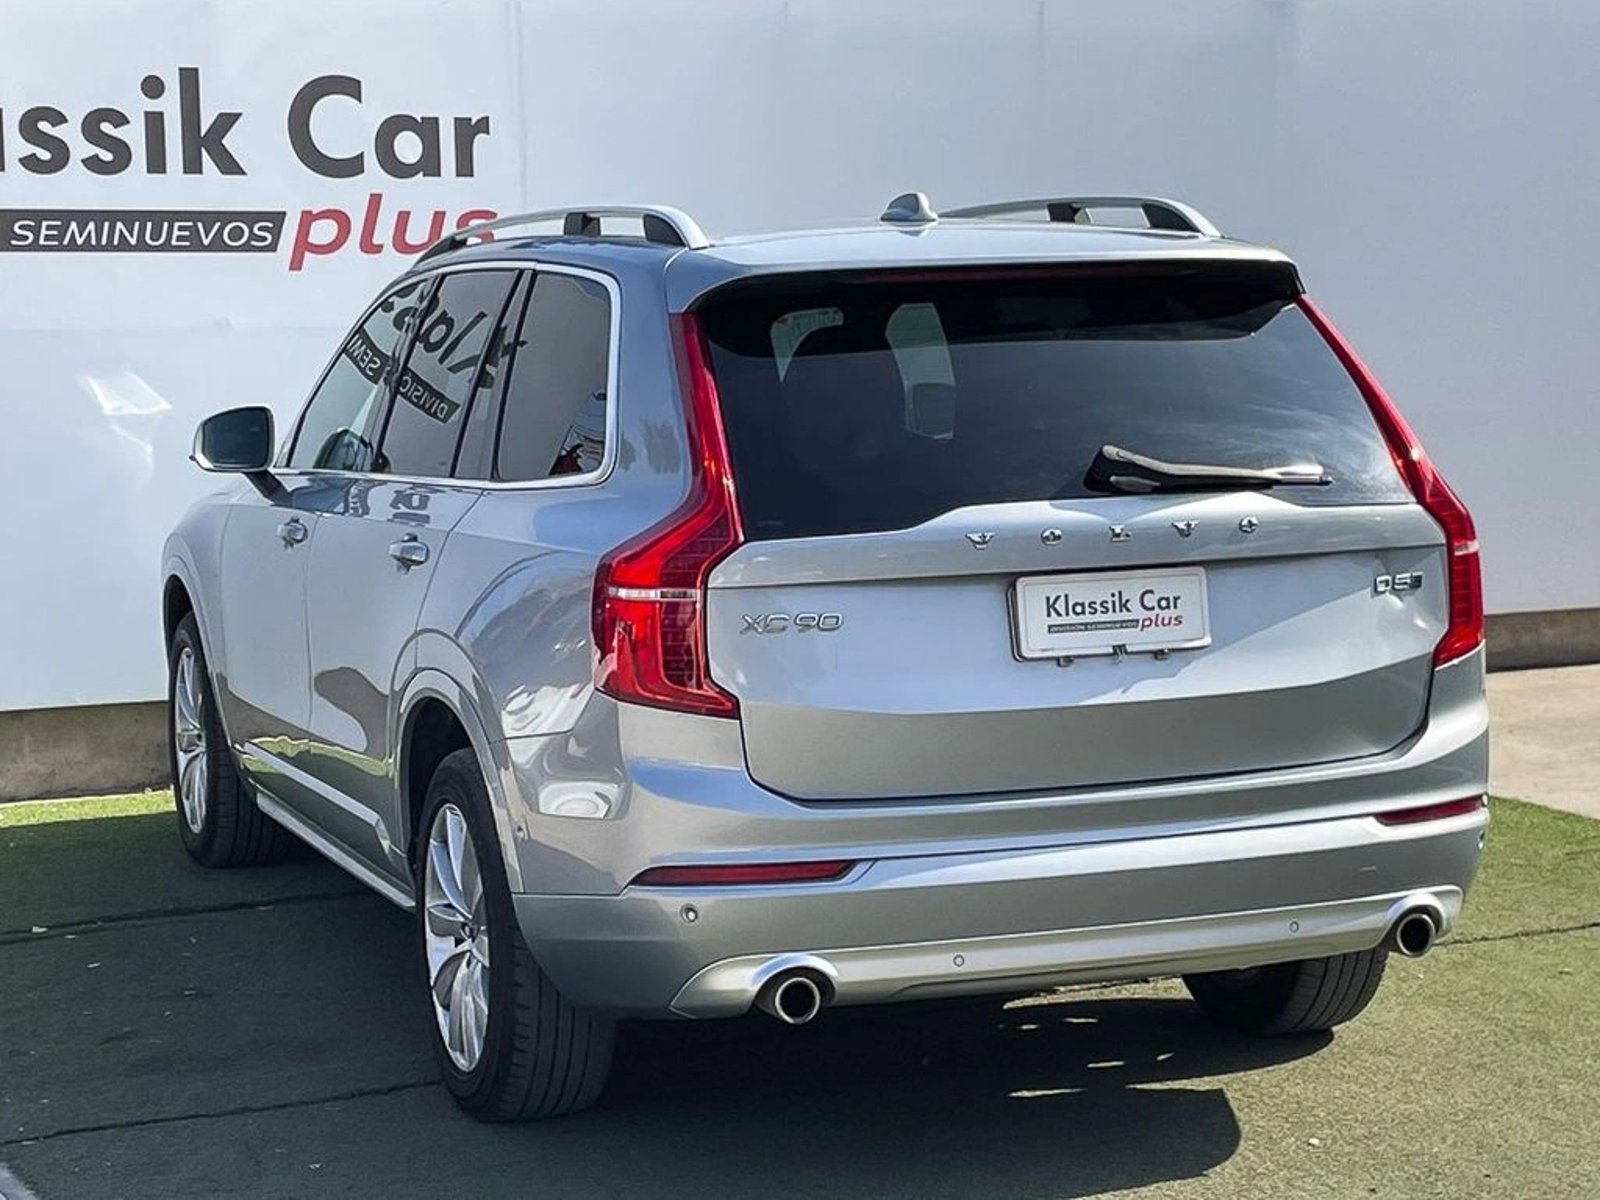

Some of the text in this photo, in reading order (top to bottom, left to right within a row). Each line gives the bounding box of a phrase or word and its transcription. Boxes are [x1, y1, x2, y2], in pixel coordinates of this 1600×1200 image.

[0, 67, 491, 179] ssik Car
[9, 220, 275, 247] SEMINUEVOS
[289, 193, 498, 271] plus
[965, 515, 1260, 550] VOLVO
[1045, 589, 1181, 618] Klassik Car
[1140, 613, 1184, 632] plus
